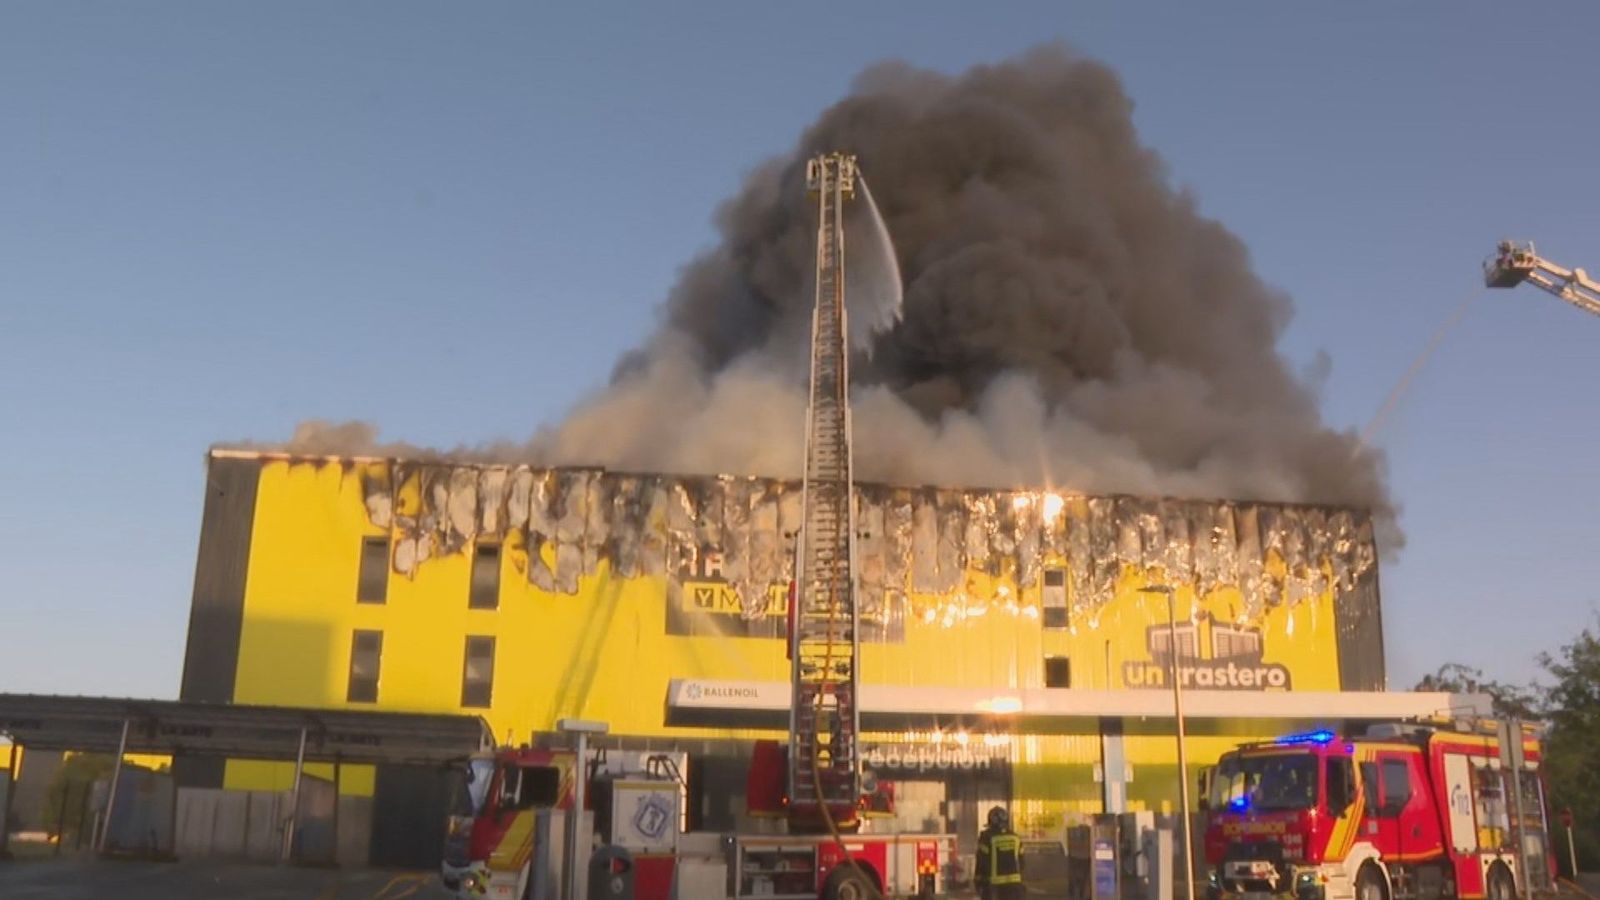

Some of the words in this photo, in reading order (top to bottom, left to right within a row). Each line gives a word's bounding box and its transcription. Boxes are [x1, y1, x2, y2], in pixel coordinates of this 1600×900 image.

[1126, 665, 1164, 686] un
[1170, 662, 1286, 687] rastero
[704, 687, 758, 698] BALLENOIL
